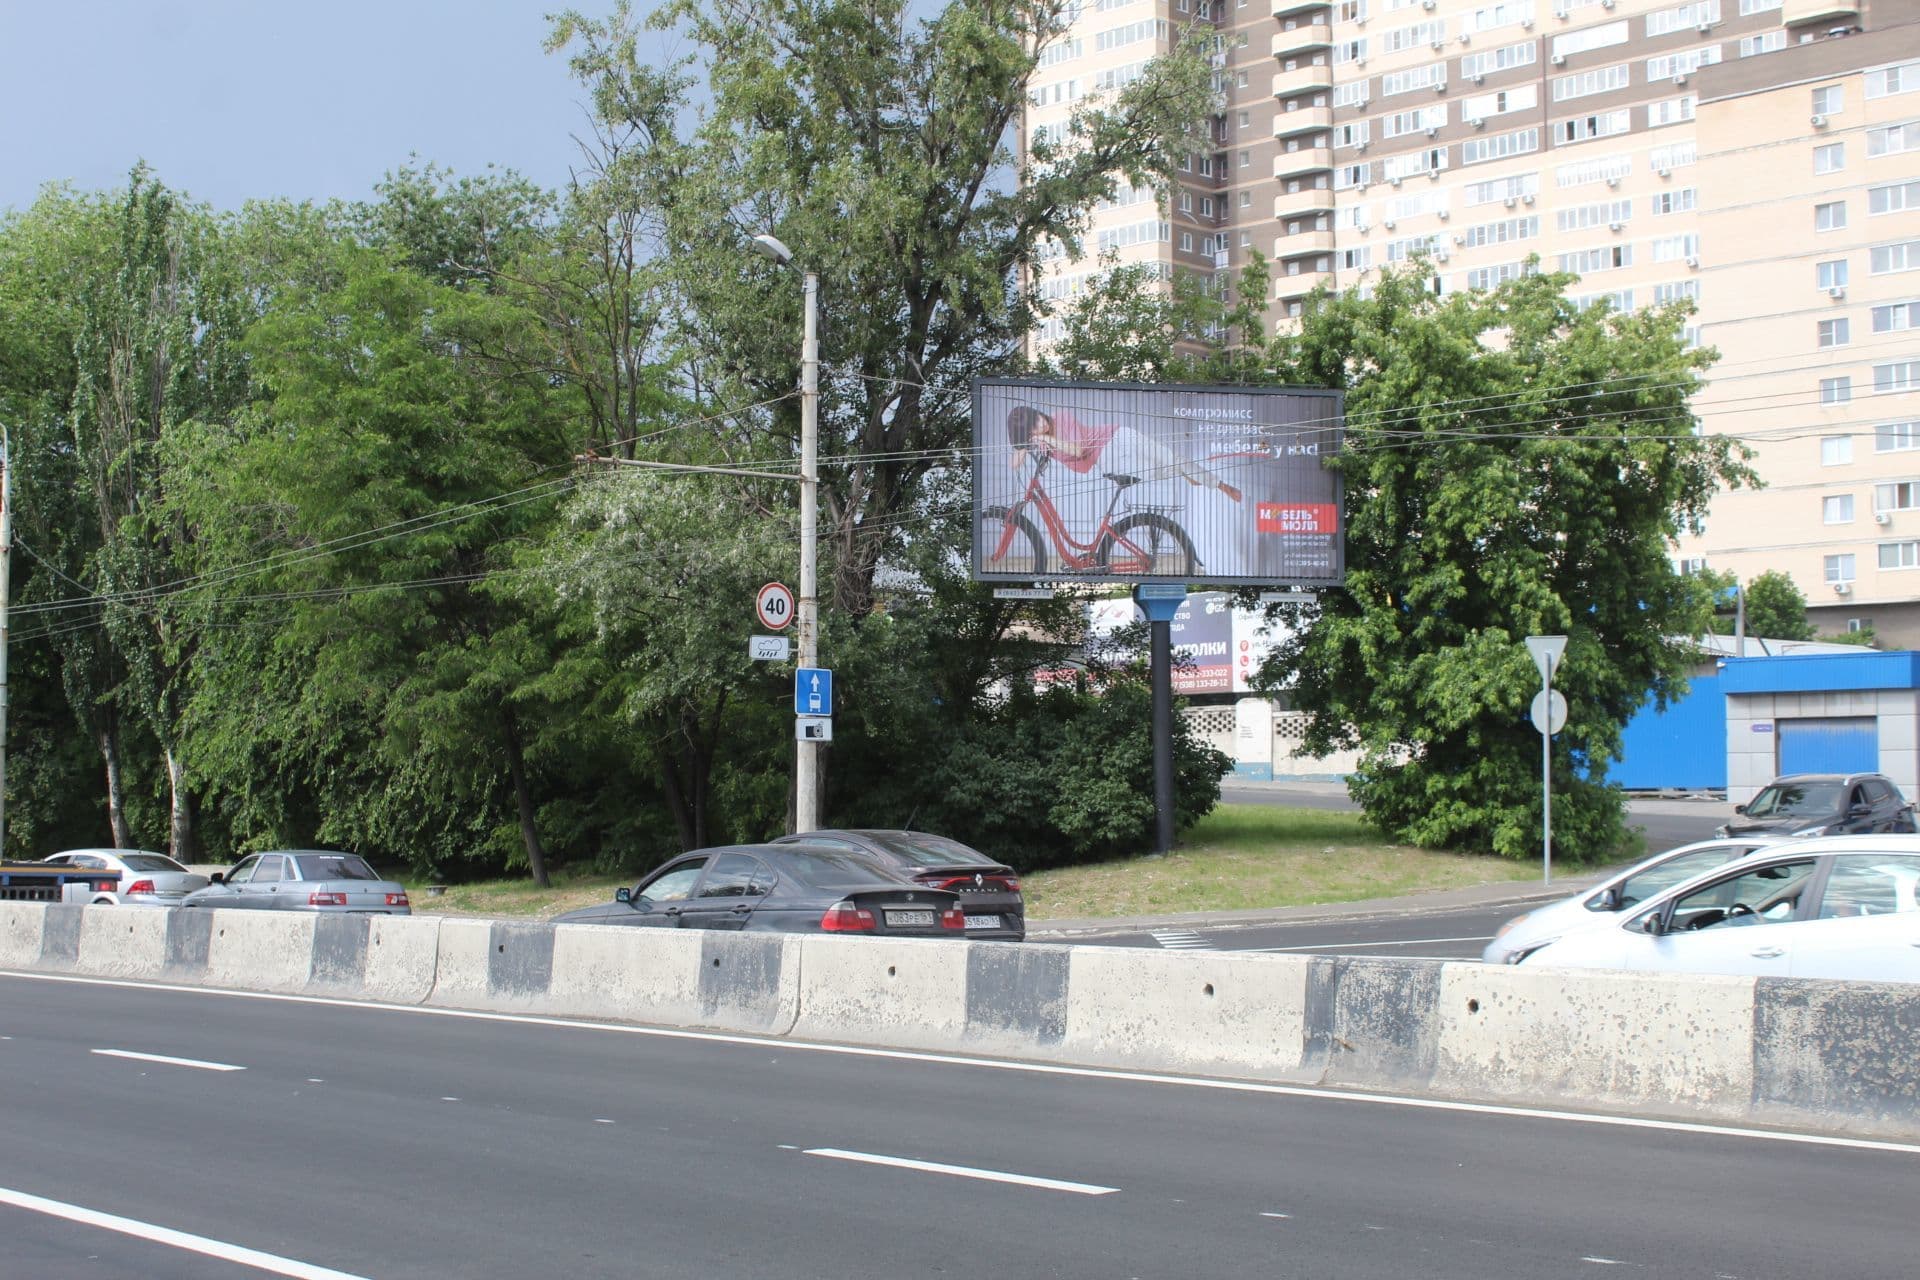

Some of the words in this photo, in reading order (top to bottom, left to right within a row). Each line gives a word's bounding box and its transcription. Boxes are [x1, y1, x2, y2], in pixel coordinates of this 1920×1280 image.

[1173, 407, 1253, 420] компромисс
[1210, 439, 1271, 454] мебель
[765, 597, 785, 615] 40
[1170, 641, 1227, 658] ОТОЛКИ
